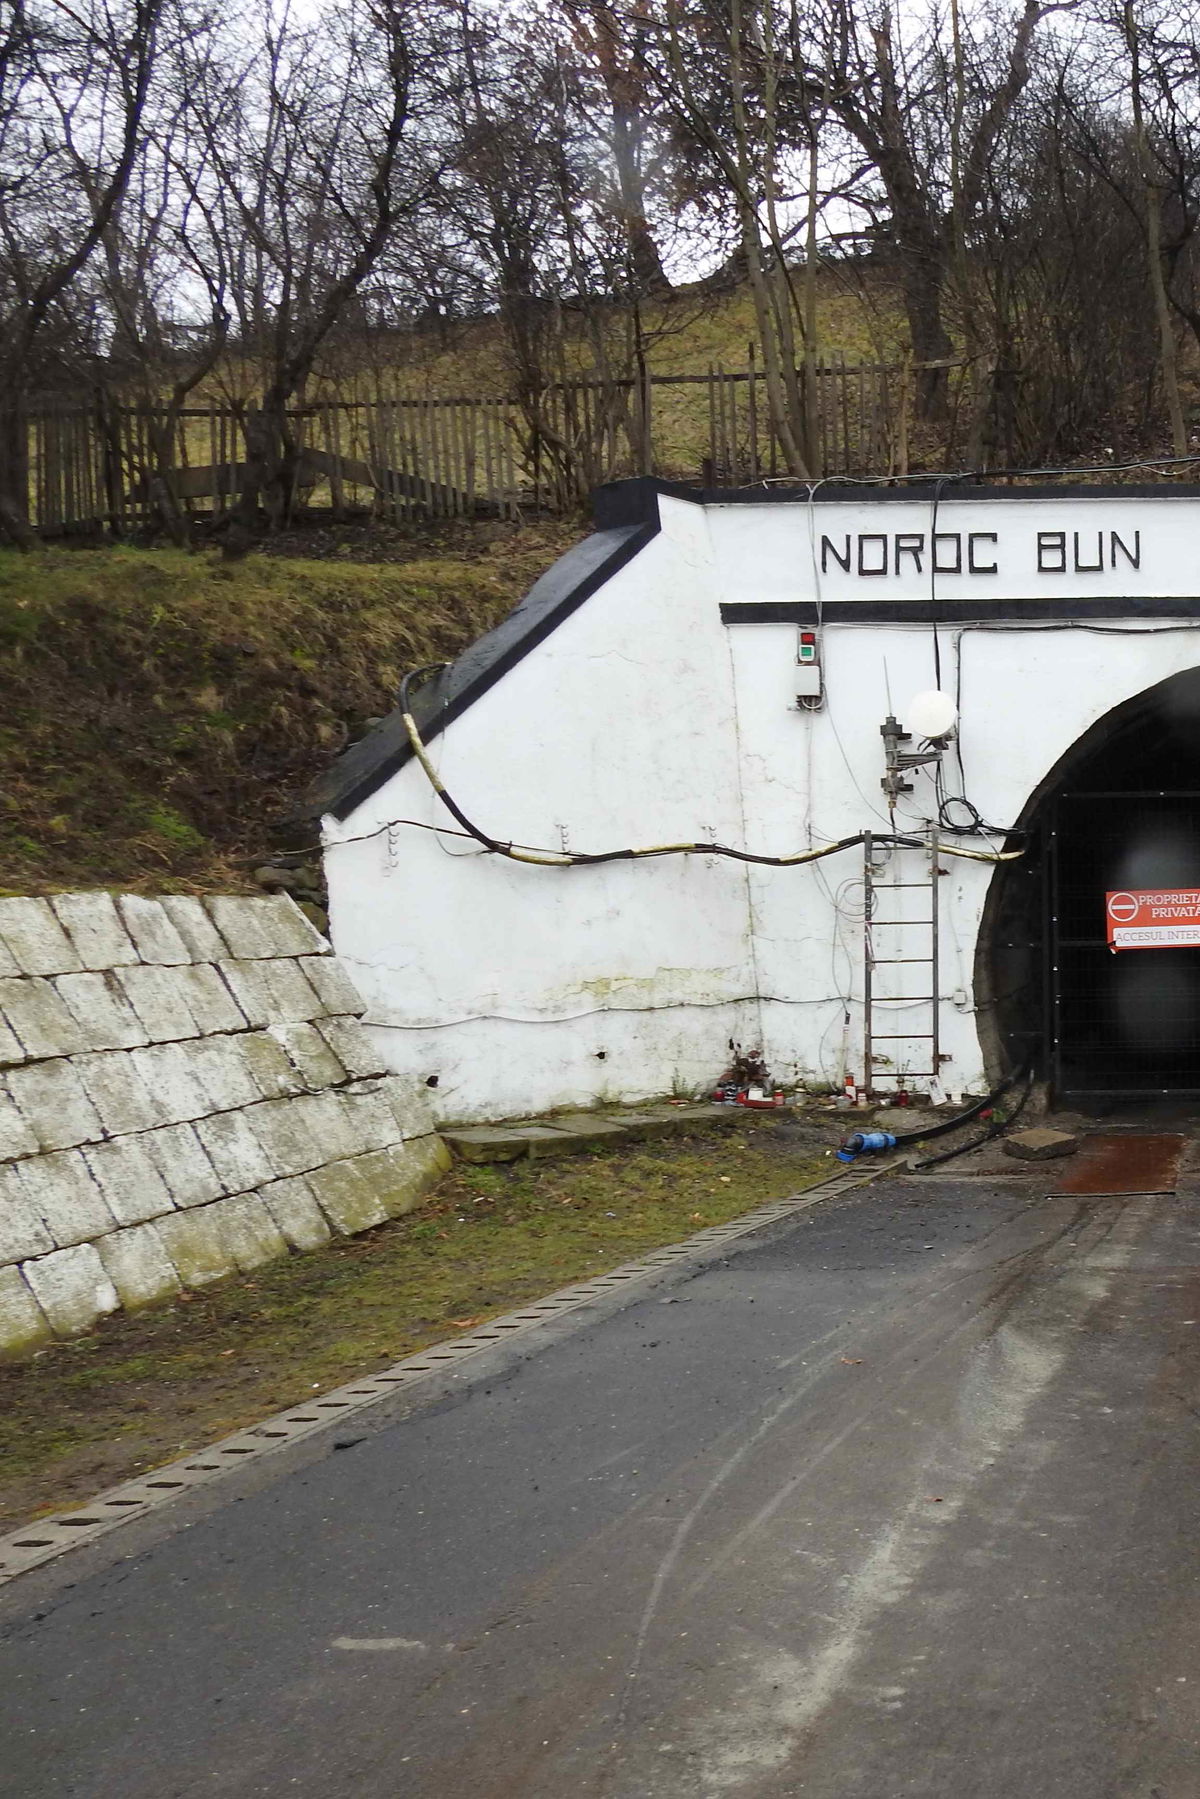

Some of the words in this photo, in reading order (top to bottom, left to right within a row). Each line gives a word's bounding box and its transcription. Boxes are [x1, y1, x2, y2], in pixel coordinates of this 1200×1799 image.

[821, 533, 997, 575] NOROC
[1037, 531, 1141, 572] BUN
[1116, 931, 1165, 942] ACCESUL
